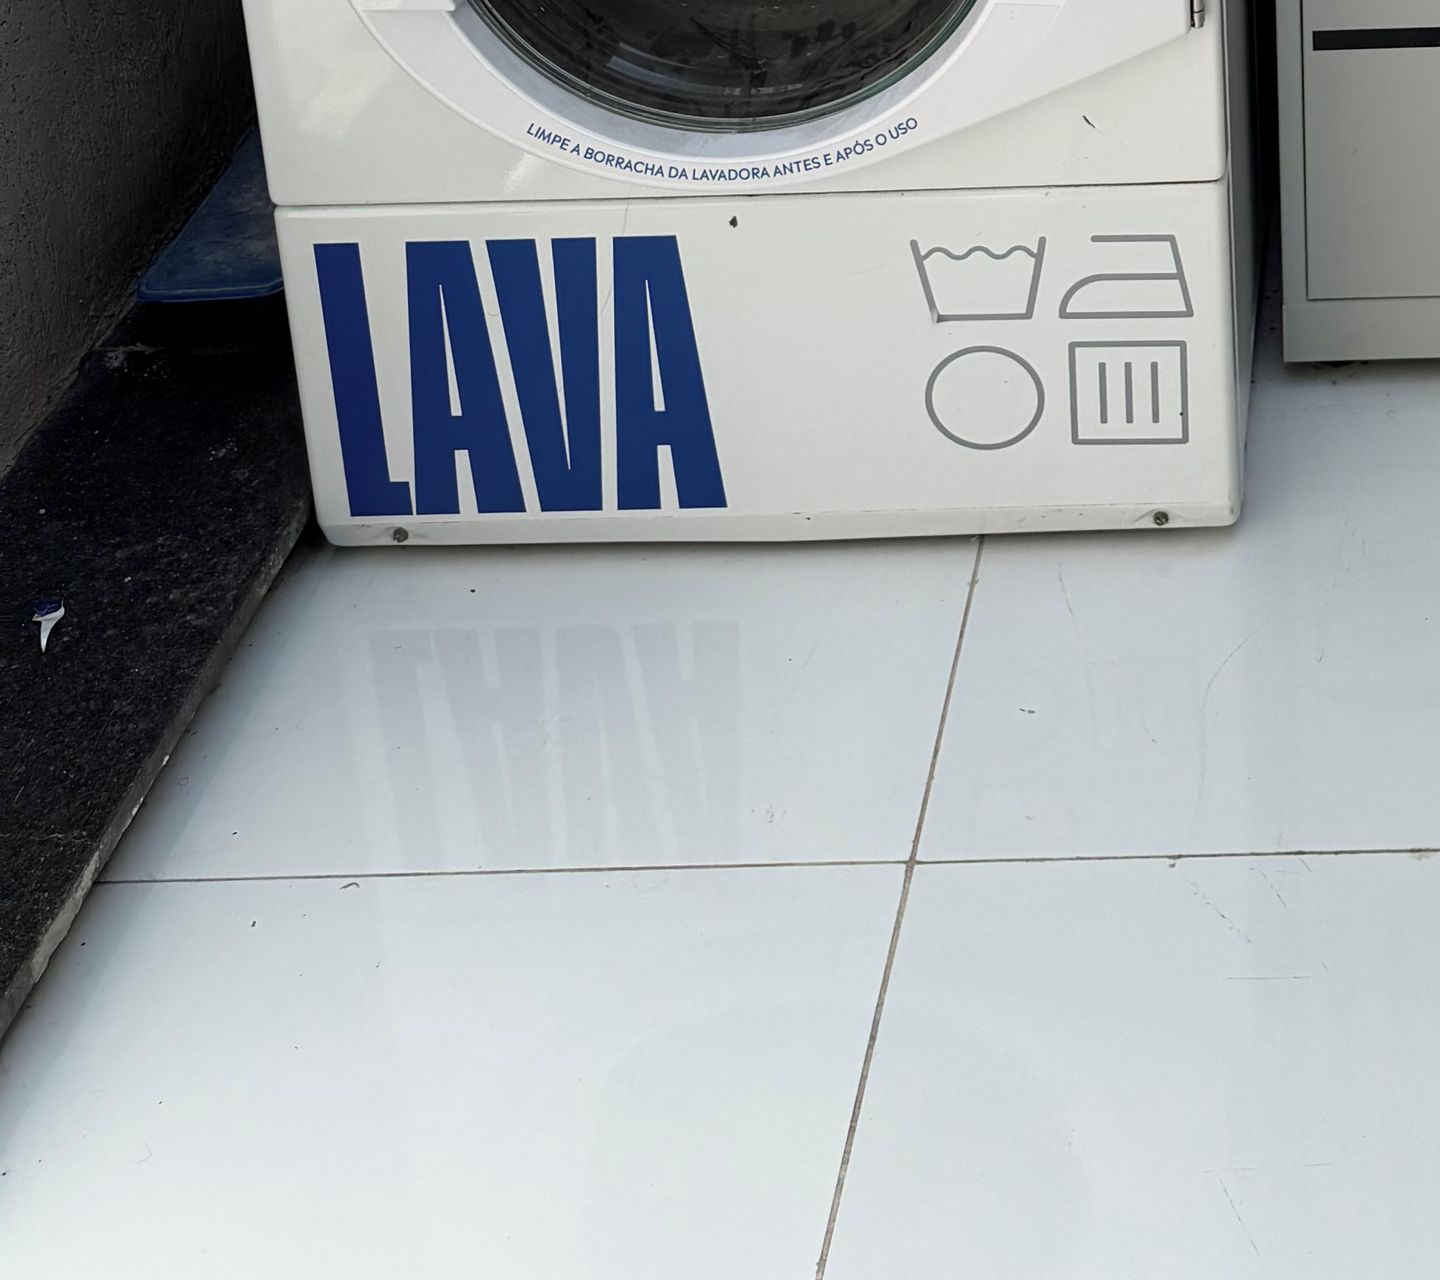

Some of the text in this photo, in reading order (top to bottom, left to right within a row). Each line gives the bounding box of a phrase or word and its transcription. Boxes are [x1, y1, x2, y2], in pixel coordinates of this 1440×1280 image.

[526, 117, 918, 182] LIMPE A BORRACHA DA LAVADORA ANTES E APÓS O USO
[313, 234, 728, 518] LAVA
